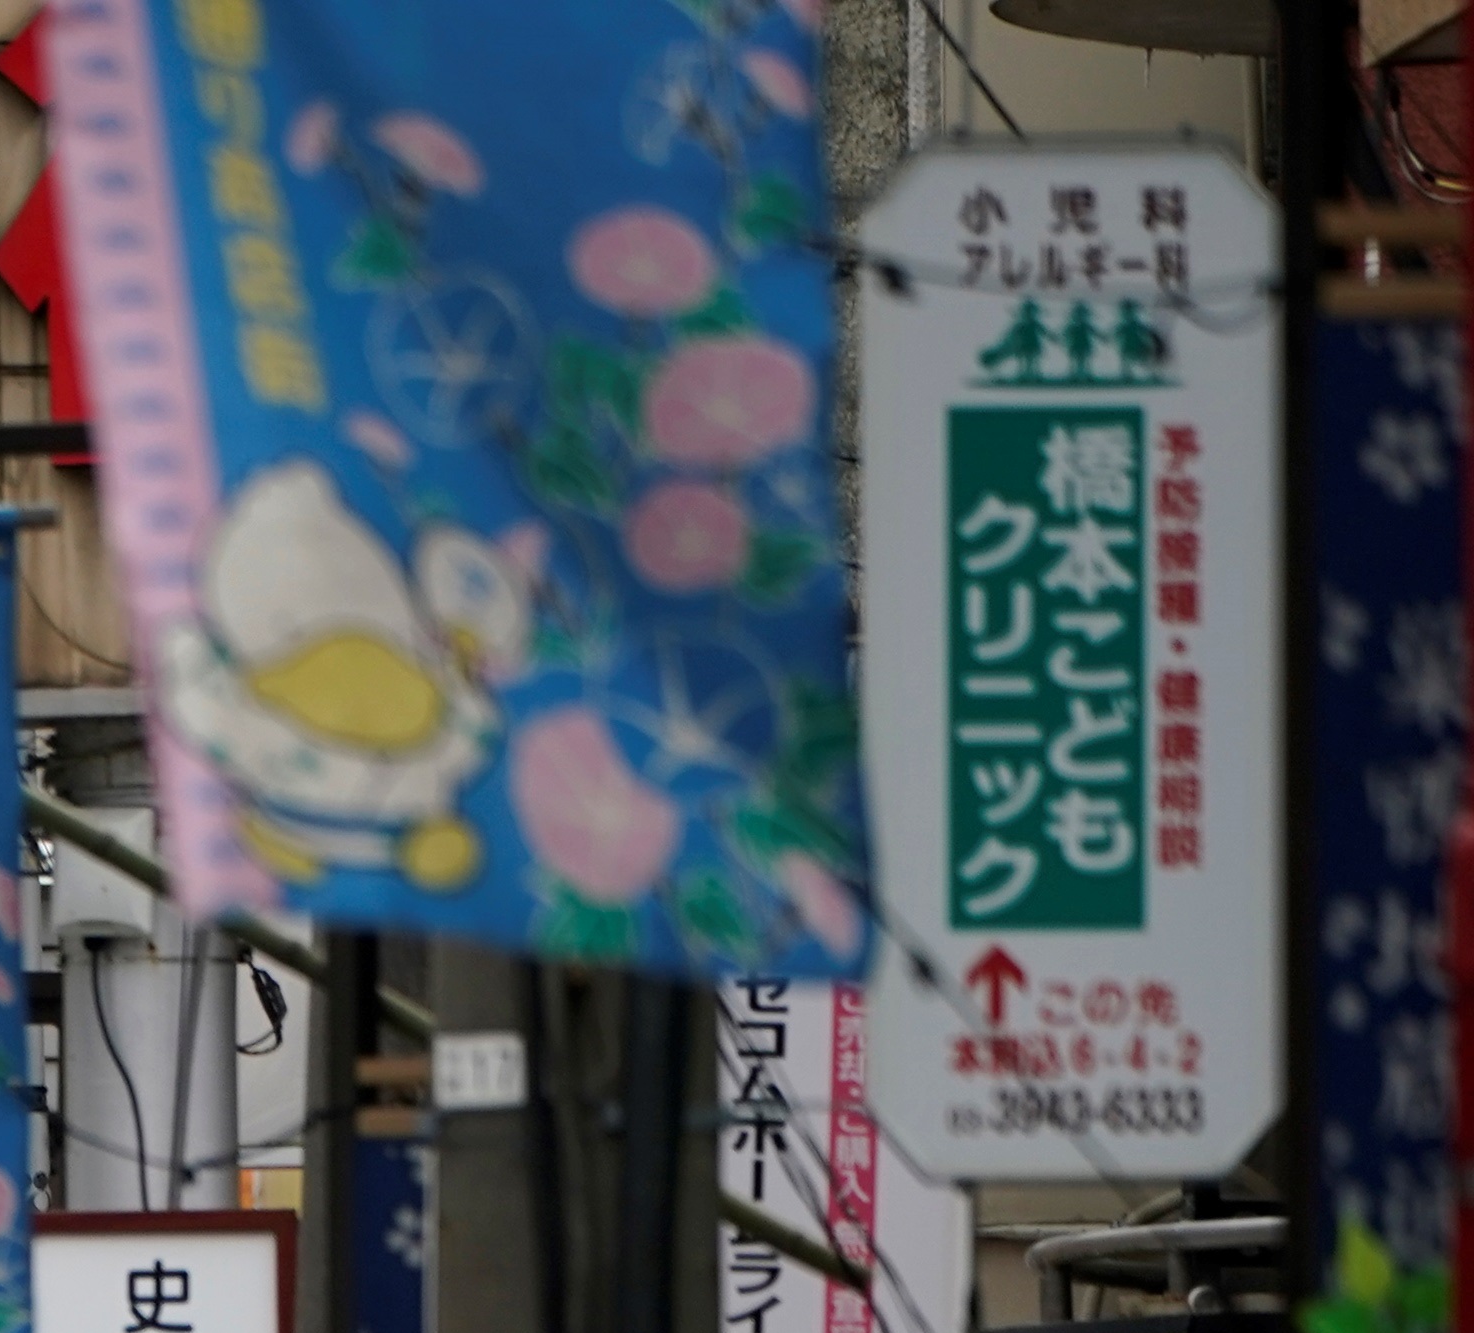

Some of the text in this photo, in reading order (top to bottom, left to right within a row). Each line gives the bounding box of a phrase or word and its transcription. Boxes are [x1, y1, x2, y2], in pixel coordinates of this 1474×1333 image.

[955, 496, 1045, 918] クリニック
[1040, 424, 1135, 874] 橋本こども
